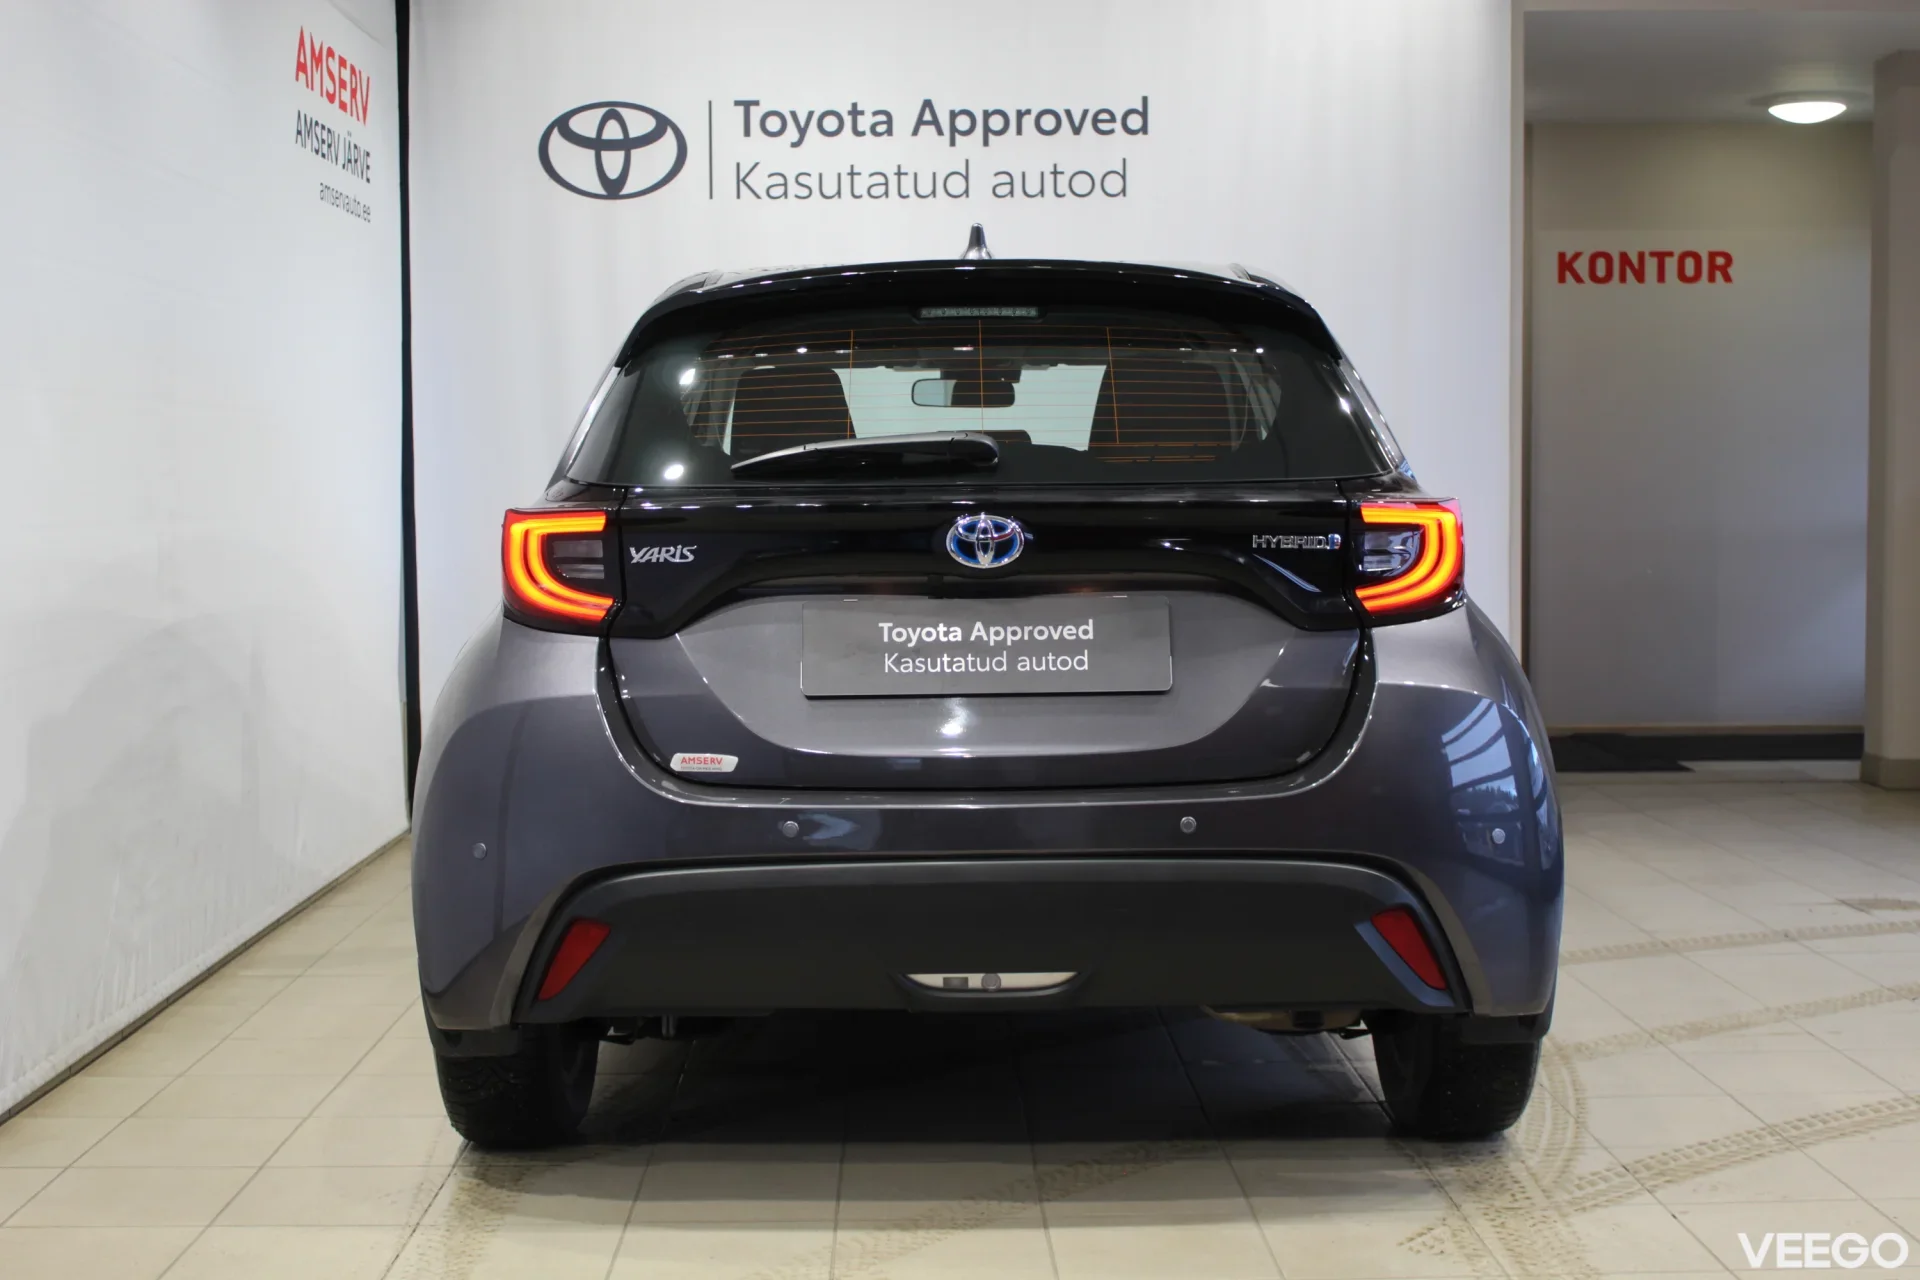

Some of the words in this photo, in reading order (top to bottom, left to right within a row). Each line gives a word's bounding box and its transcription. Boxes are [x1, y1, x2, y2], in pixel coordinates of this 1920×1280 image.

[295, 25, 370, 126] AMSERV
[734, 99, 894, 149] Toyota
[911, 96, 1150, 148] Approved
[295, 109, 340, 167] AMSERV
[342, 130, 371, 184] JÄRVE
[735, 158, 970, 200] Kasutatud
[991, 157, 1128, 199] autod
[319, 181, 371, 224] amservauto.ee
[1557, 250, 1734, 284] KONTOR
[629, 544, 698, 564] YARIS
[1252, 534, 1328, 550] HYBRID
[878, 622, 963, 648] Toyota
[969, 618, 1095, 647] Approved
[884, 650, 1008, 674] Kasutatud
[1016, 649, 1090, 672] autod
[680, 756, 724, 766] AMSERV
